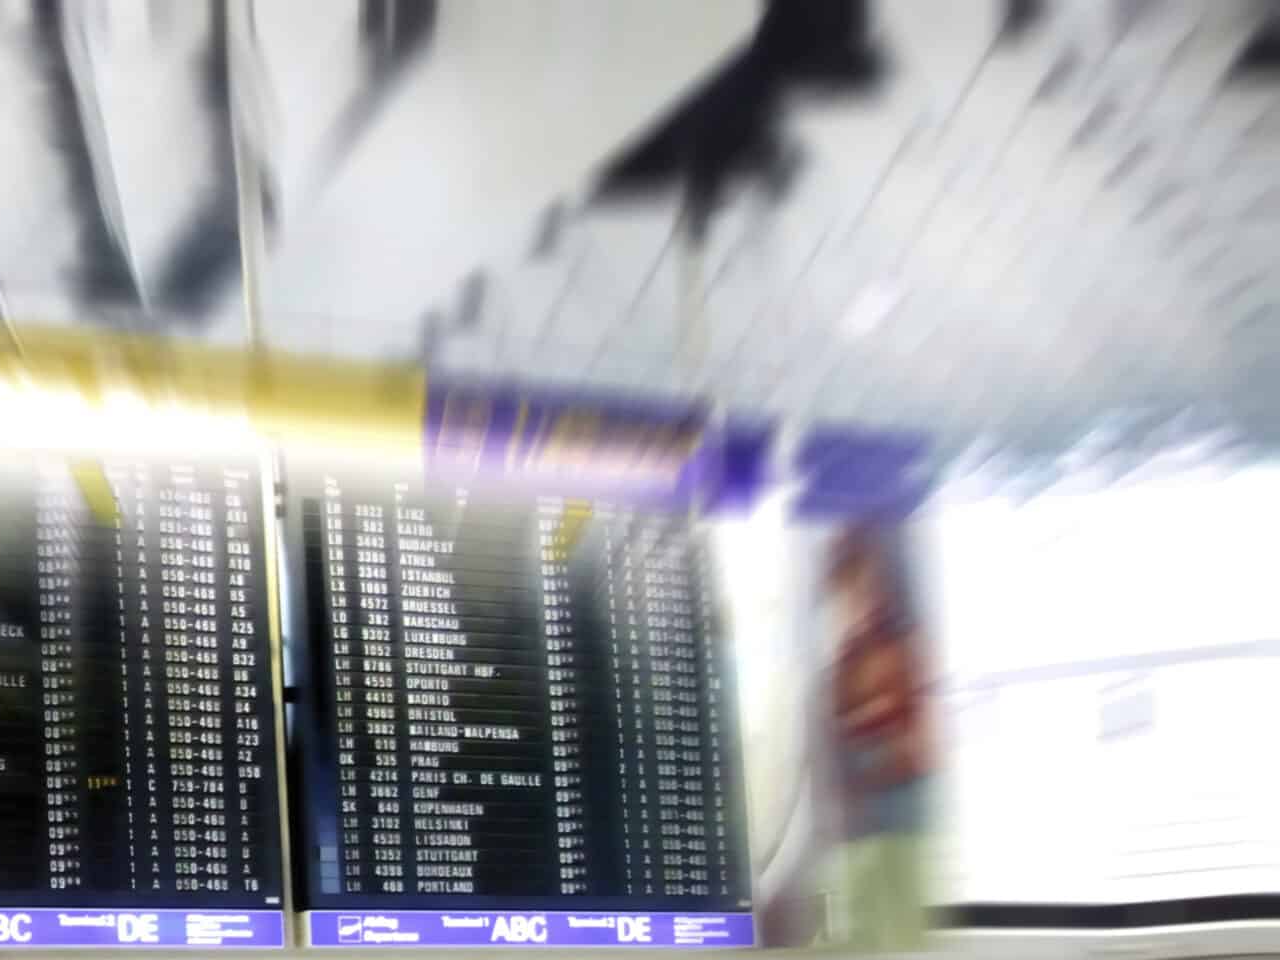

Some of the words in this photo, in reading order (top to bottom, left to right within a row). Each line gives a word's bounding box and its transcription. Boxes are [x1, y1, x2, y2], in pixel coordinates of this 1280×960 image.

[399, 539, 454, 553] BUDAPEST
[400, 555, 434, 567] ATHEN
[402, 570, 457, 584] ISTANBUL
[401, 586, 449, 599] ZUERICH
[402, 601, 457, 615] BRUESSEL
[403, 617, 458, 630] WARSCHAU
[404, 632, 466, 646] LUXEMBURG
[405, 648, 453, 660] DRESDEN
[406, 664, 466, 675] STUTTGART
[407, 679, 448, 691] OPORTO
[408, 695, 448, 706] MADRID
[408, 710, 456, 722] BRISTOL
[410, 741, 458, 753] HAMBURG
[370, 771, 397, 783] 4214
[412, 772, 446, 782] PARIS
[480, 774, 493, 785] DE
[502, 774, 542, 786] GAULLE
[414, 803, 482, 815] KOPENHAGEN
[414, 819, 469, 830] HELSINKI
[415, 835, 470, 845] LISSABON
[416, 850, 478, 861] STUTTGART
[417, 866, 472, 876] BORDEAUX
[418, 881, 473, 892] PORTLAND
[117, 914, 159, 943] DE
[491, 916, 547, 942] ABC
[617, 916, 652, 942] DE
